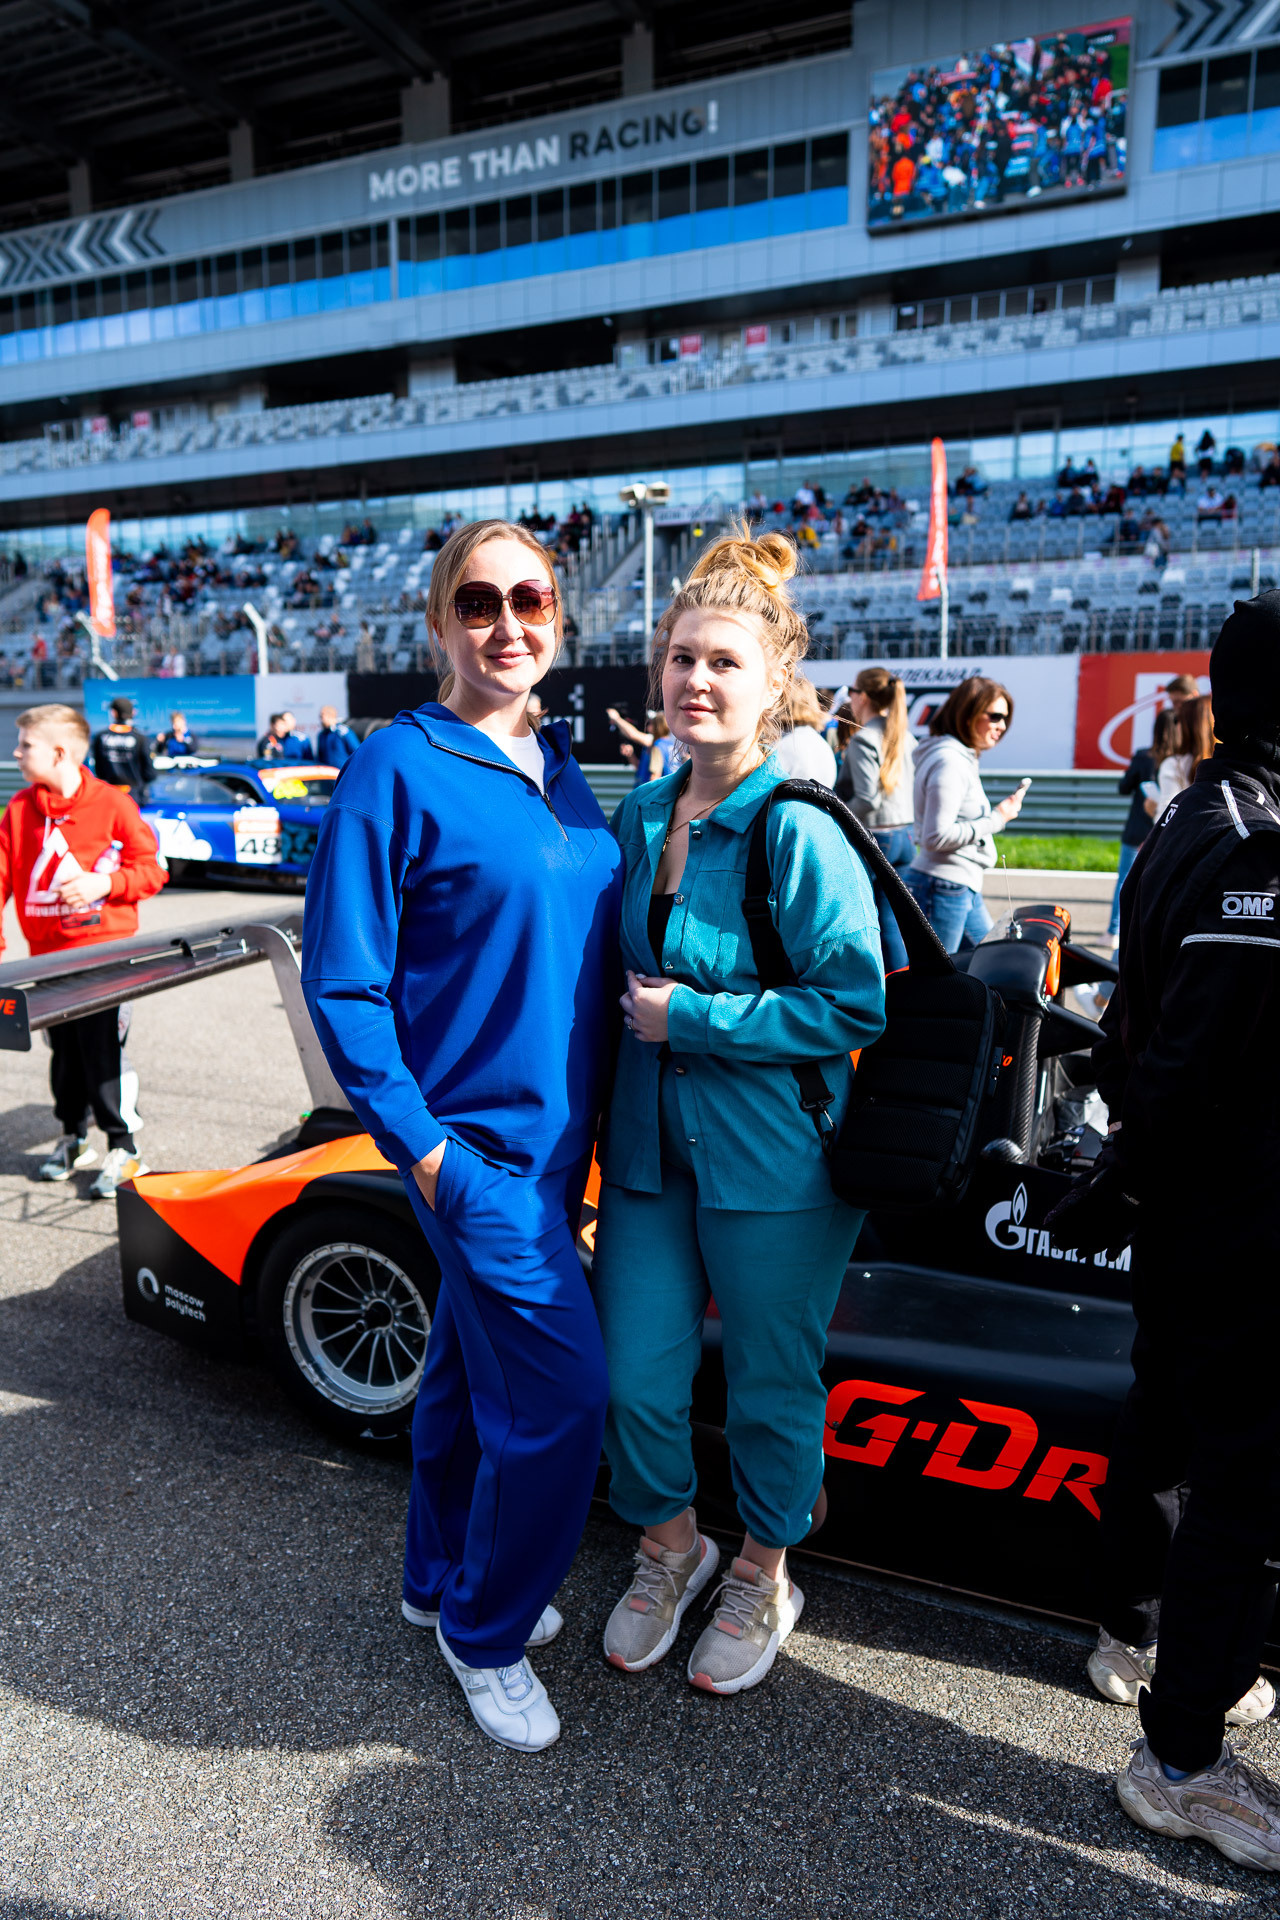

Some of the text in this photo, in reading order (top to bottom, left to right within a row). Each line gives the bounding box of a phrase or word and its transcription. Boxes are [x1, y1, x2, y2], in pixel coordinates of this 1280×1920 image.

[369, 100, 719, 201] MORE THAN RACING!
[241, 838, 281, 855] 48
[1222, 896, 1274, 916] OMP
[165, 1285, 204, 1308] moscow
[165, 1297, 206, 1322] polytech
